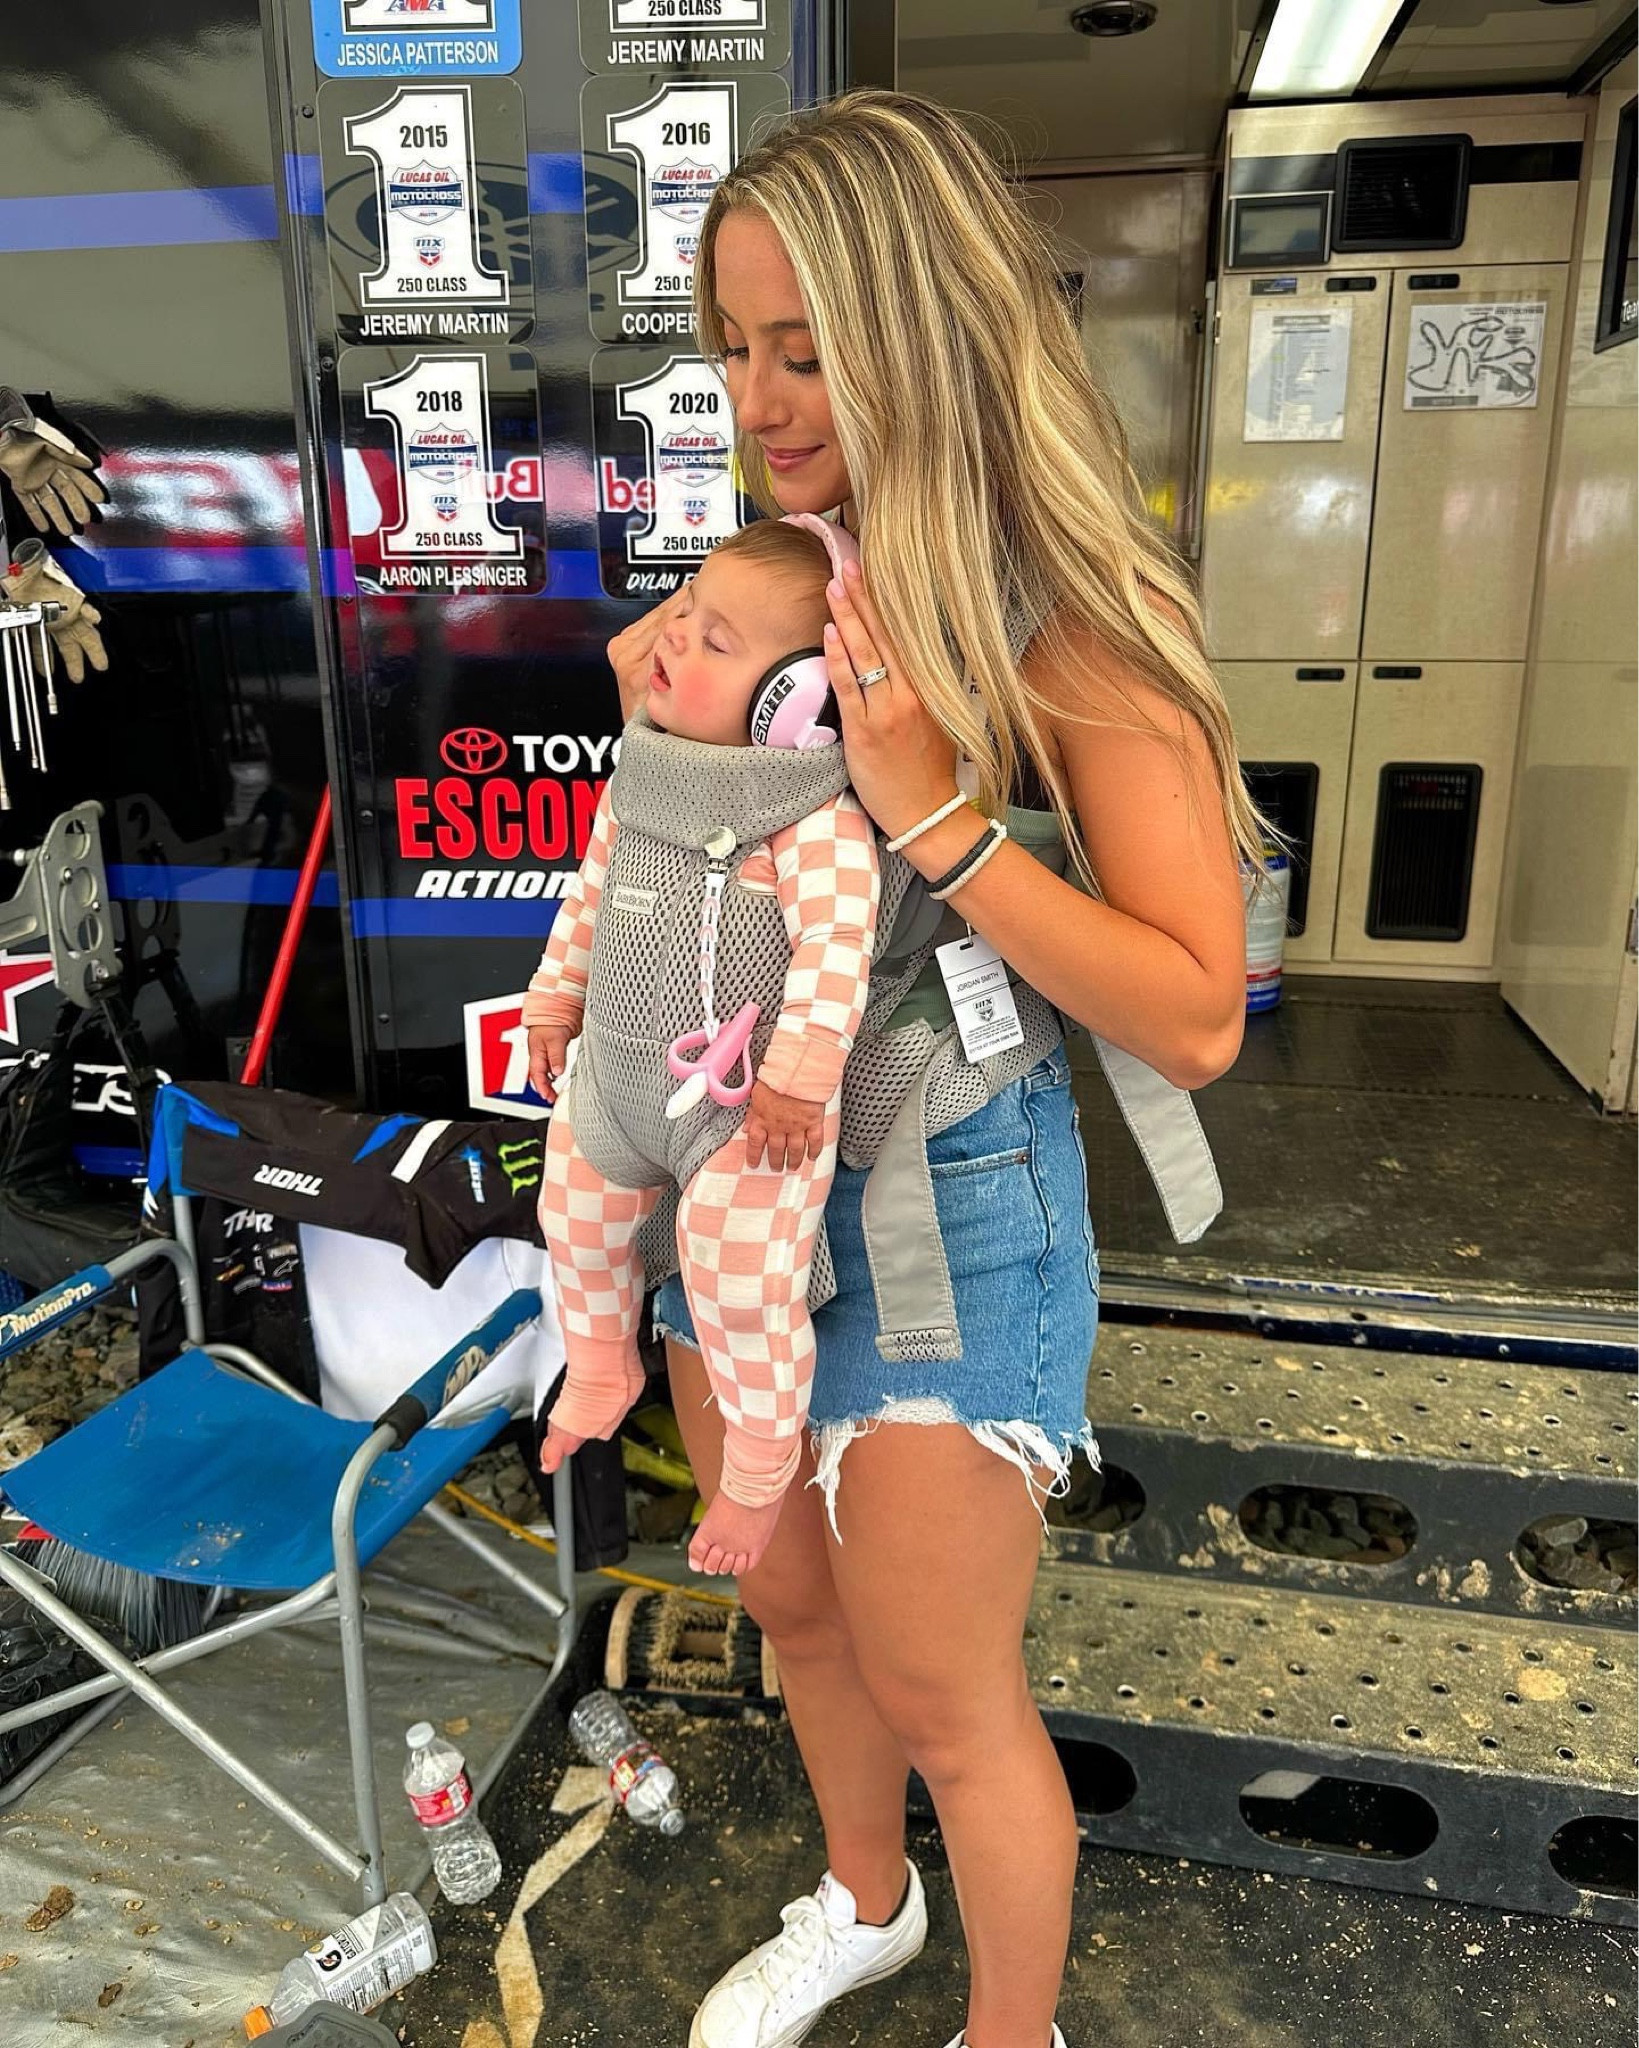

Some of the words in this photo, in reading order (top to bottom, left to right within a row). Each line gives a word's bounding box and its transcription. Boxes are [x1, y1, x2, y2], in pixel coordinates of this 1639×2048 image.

[648, 0, 675, 16] 250
[679, 0, 722, 16] CLASS
[337, 42, 403, 66] JESSICA
[406, 40, 499, 65] PATTERSON
[607, 39, 686, 65] JEREMY
[691, 37, 764, 62] MARTIN
[399, 124, 448, 148] 2015
[661, 122, 711, 145] 2016
[399, 172, 433, 183] LUCAS
[434, 172, 450, 182] OIL
[661, 170, 695, 180] LUCAS
[696, 169, 713, 180] OIL
[343, 84, 511, 306] 1
[391, 190, 462, 201] MOTOCROSS
[397, 277, 422, 292] 250
[426, 276, 467, 292] CLASS
[654, 275, 680, 291] 250
[359, 314, 434, 336] JEREMY
[438, 312, 509, 335] MARTIN
[416, 390, 463, 412] 2018
[669, 392, 719, 414] 2020
[417, 435, 449, 444] LUCAS
[450, 434, 466, 444] OIL
[668, 437, 700, 447] LUCAS
[702, 436, 718, 447] OIL
[363, 353, 525, 560] 1
[410, 452, 478, 461] MOTOCROSS
[660, 455, 728, 464] MOTOCROSS
[415, 532, 441, 547] 250
[443, 532, 483, 546] CLASS
[662, 536, 687, 551] 250
[379, 566, 432, 587] AARON
[435, 564, 528, 587] PLESSINGER
[626, 572, 679, 590] DYLAN
[754, 675, 796, 744] SMITH
[512, 734, 621, 773] TOY
[395, 777, 607, 860] ESCON
[956, 978, 981, 993] JORDAN
[980, 971, 999, 984] SMITH
[253, 1163, 323, 1196] THOR
